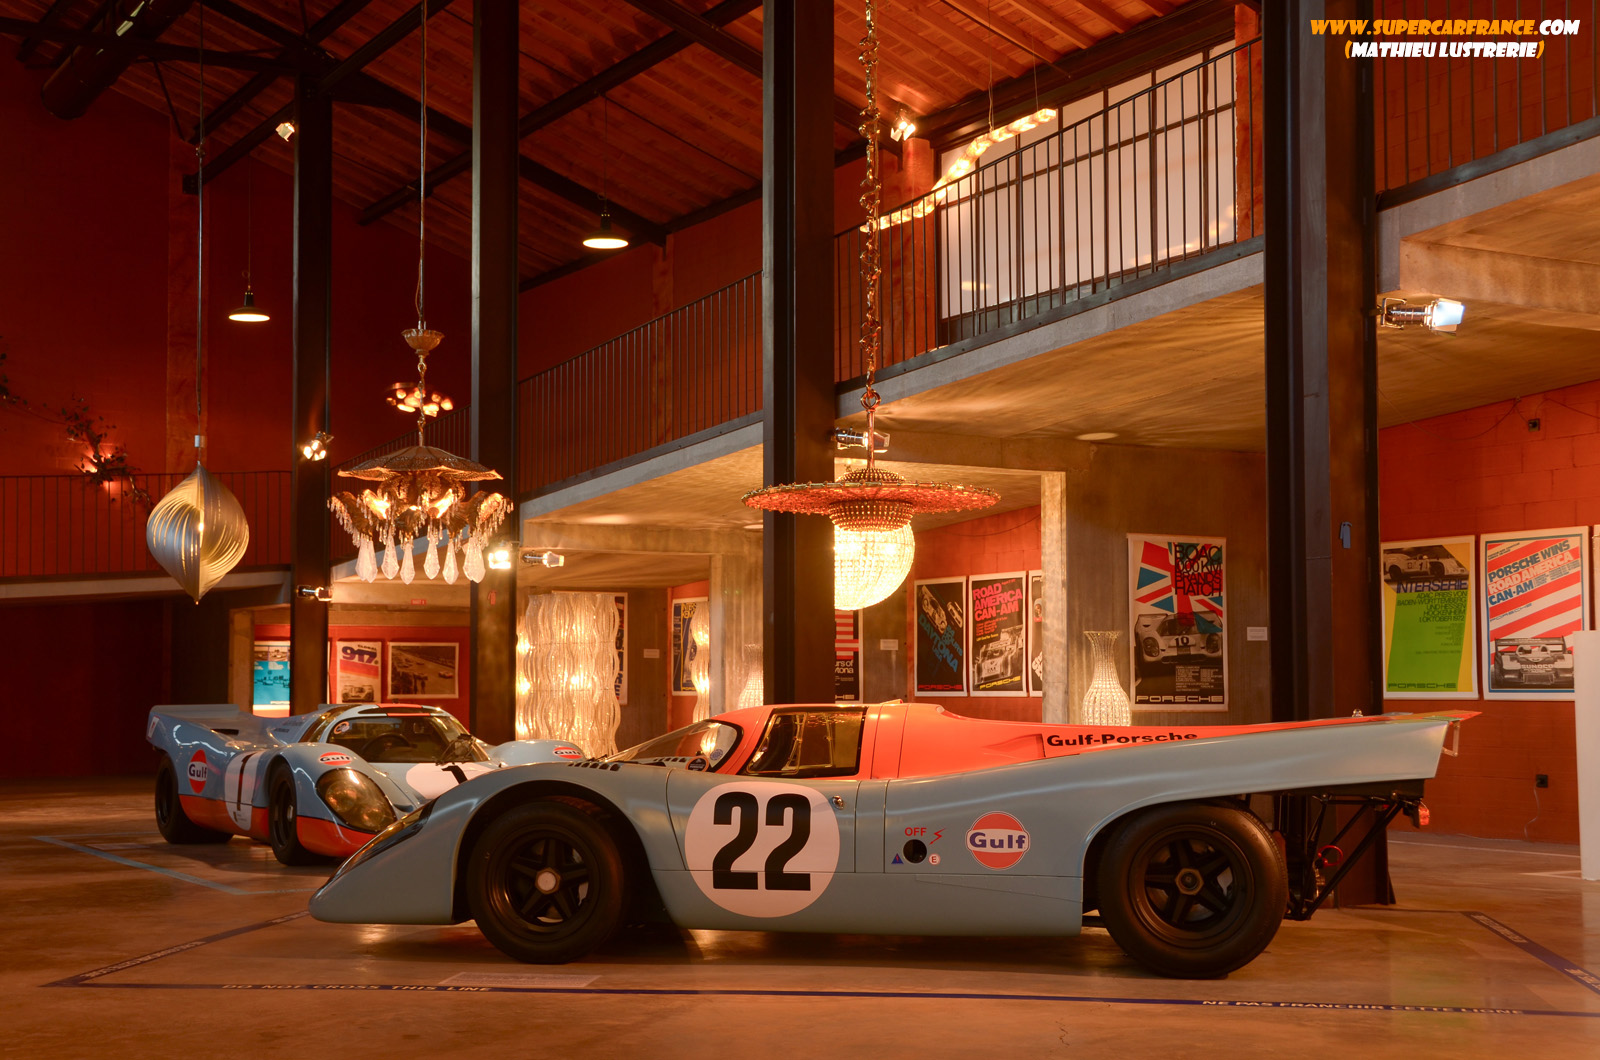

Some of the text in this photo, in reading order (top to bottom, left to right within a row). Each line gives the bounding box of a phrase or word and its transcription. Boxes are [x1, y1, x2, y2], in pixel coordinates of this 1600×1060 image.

[1175, 544, 1221, 562] BOAC
[1488, 553, 1541, 582] PORSCHE
[1541, 540, 1570, 560] WINS
[1174, 571, 1222, 584] BRANDS
[1488, 573, 1521, 595] ROAD
[1521, 551, 1574, 580] AMERICA
[973, 583, 1002, 600] ROAD
[1174, 580, 1222, 597] HATCH
[1396, 579, 1468, 594] INTERSERIE
[974, 588, 1023, 611] AMERICA
[974, 600, 1020, 621] CAN-AM
[918, 614, 958, 672] DAYTONA
[1174, 636, 1190, 646] 10
[342, 646, 377, 664] 917
[980, 675, 1021, 690] PORSCHE
[1046, 732, 1198, 746] Gulf-Porsche
[319, 755, 352, 763] Gulf
[188, 763, 209, 780] Gulf
[904, 826, 927, 837] OFF
[712, 790, 812, 892] 22
[969, 831, 1027, 850] Gulf
[1279, 1002, 1385, 1010] FRANCHIR
